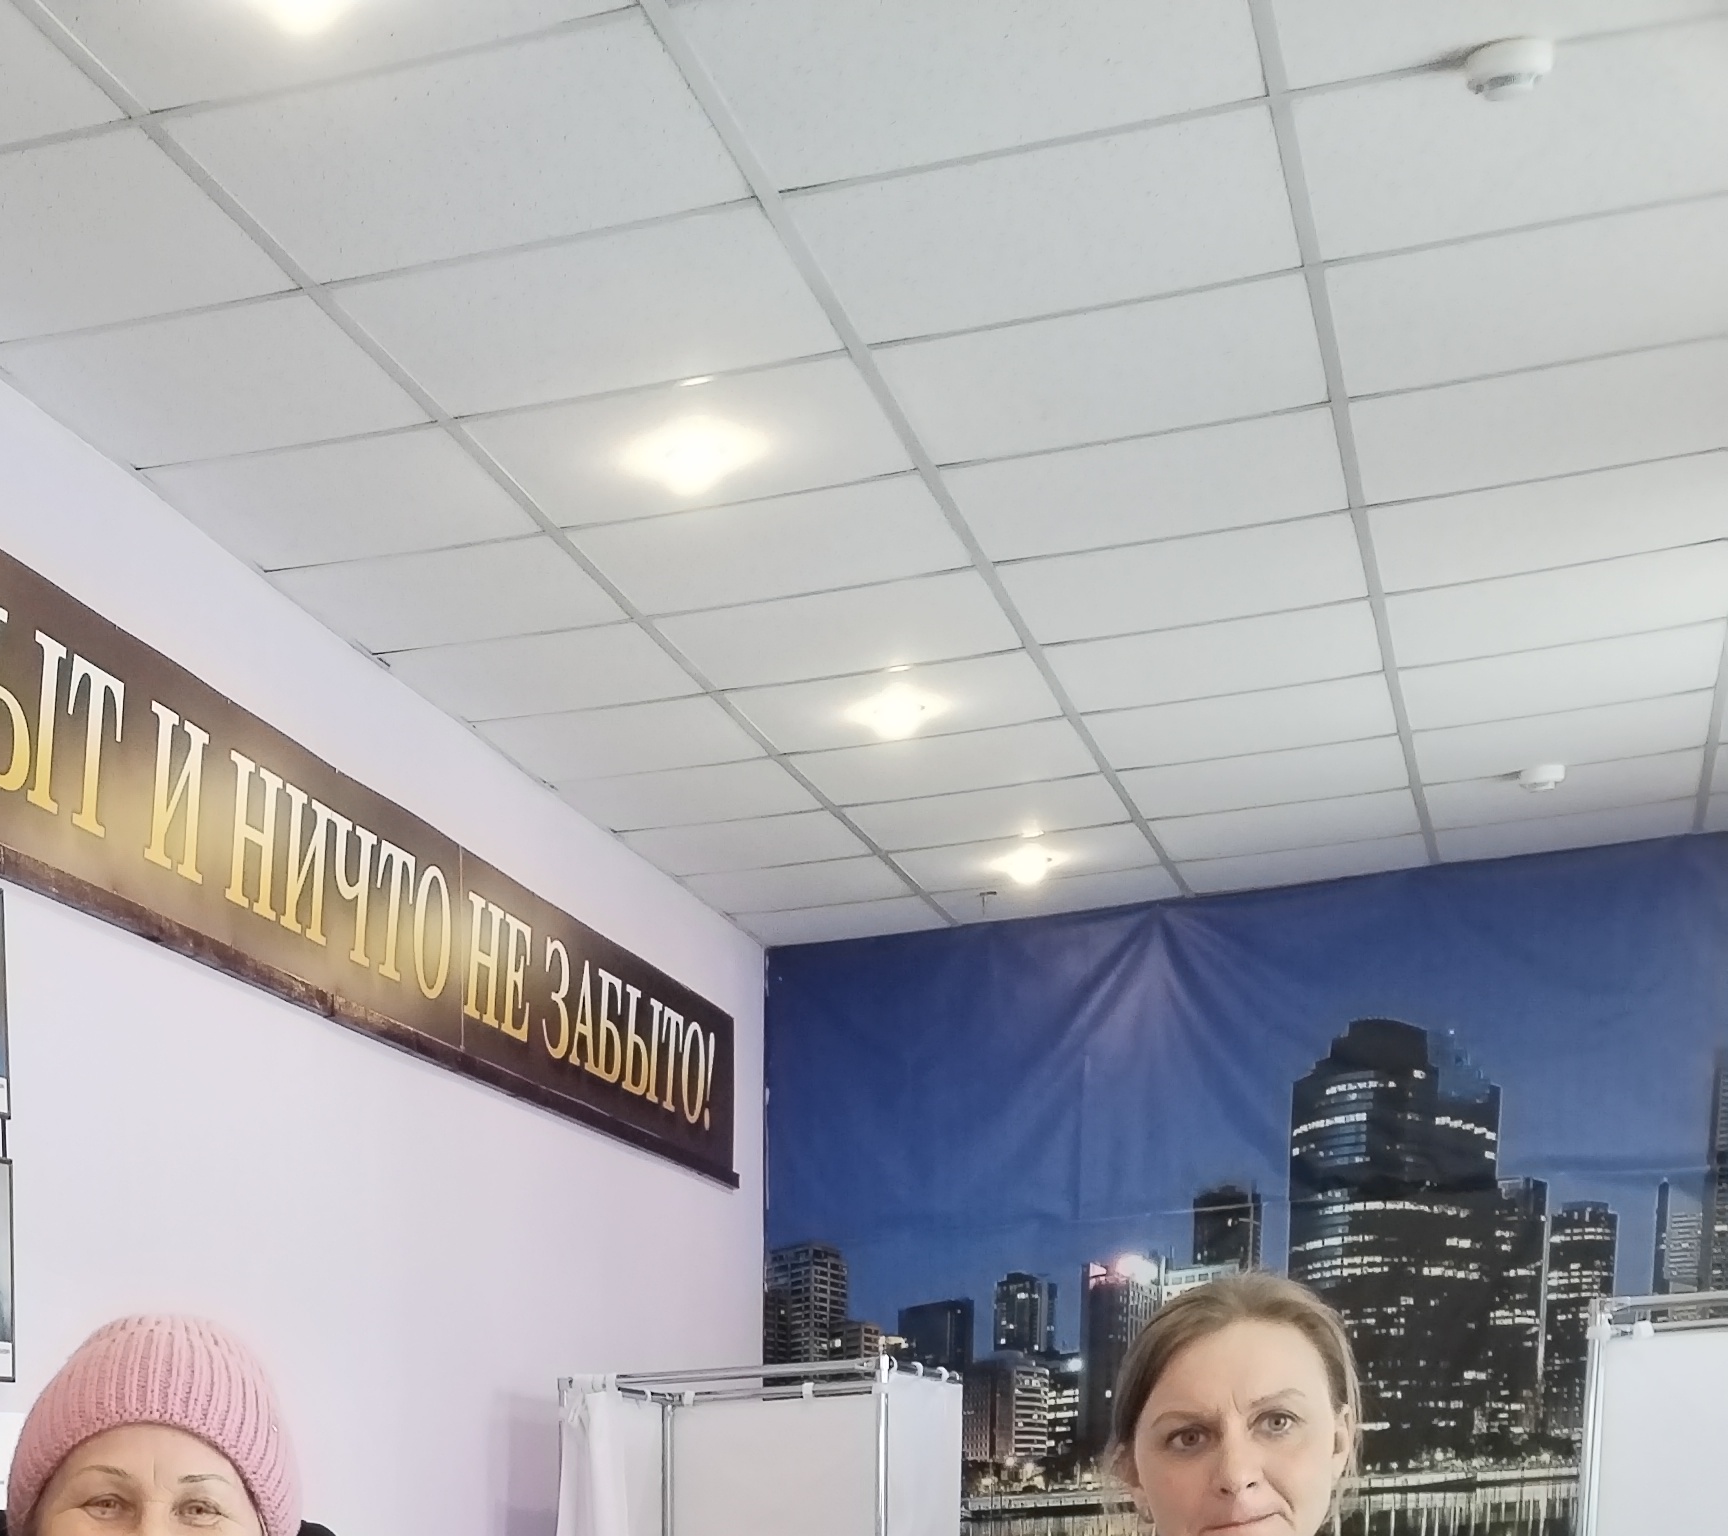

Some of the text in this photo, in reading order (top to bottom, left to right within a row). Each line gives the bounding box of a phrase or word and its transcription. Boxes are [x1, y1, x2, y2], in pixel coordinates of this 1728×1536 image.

[143, 700, 210, 884] И
[224, 749, 452, 999] НИЧТО
[463, 891, 532, 1042] НЕ
[541, 935, 716, 1132] ЗАБЫТО!
